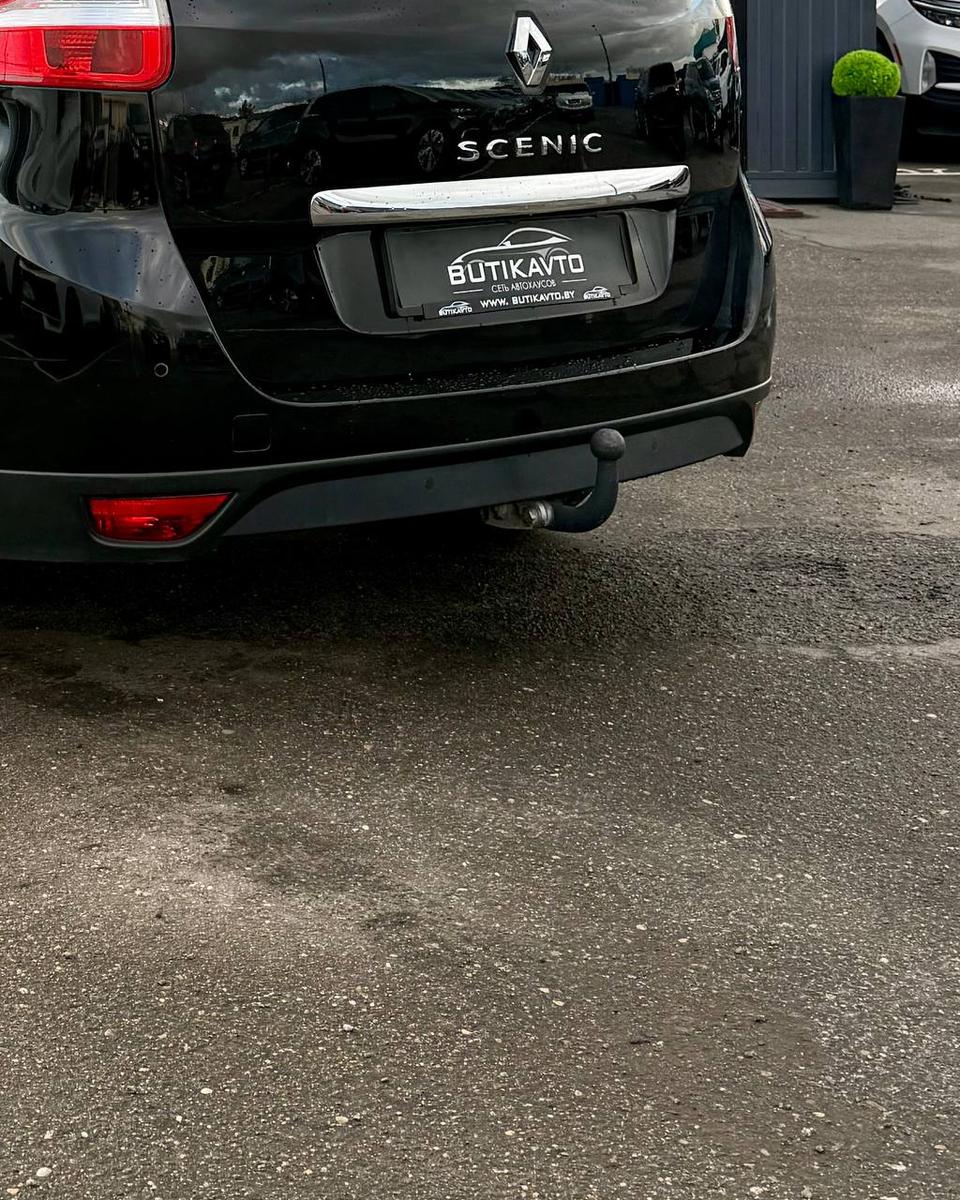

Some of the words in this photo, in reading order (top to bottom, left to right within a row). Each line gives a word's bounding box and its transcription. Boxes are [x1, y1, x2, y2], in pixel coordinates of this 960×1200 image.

[456, 132, 602, 162] SCENIC
[447, 253, 585, 286] BUTIKAVTO
[491, 284, 509, 293] СЕТЬ
[511, 279, 557, 292] АВТОХАУСОВ
[480, 297, 509, 308] WWW.
[512, 290, 576, 305] BUTIKAVTO.BY
